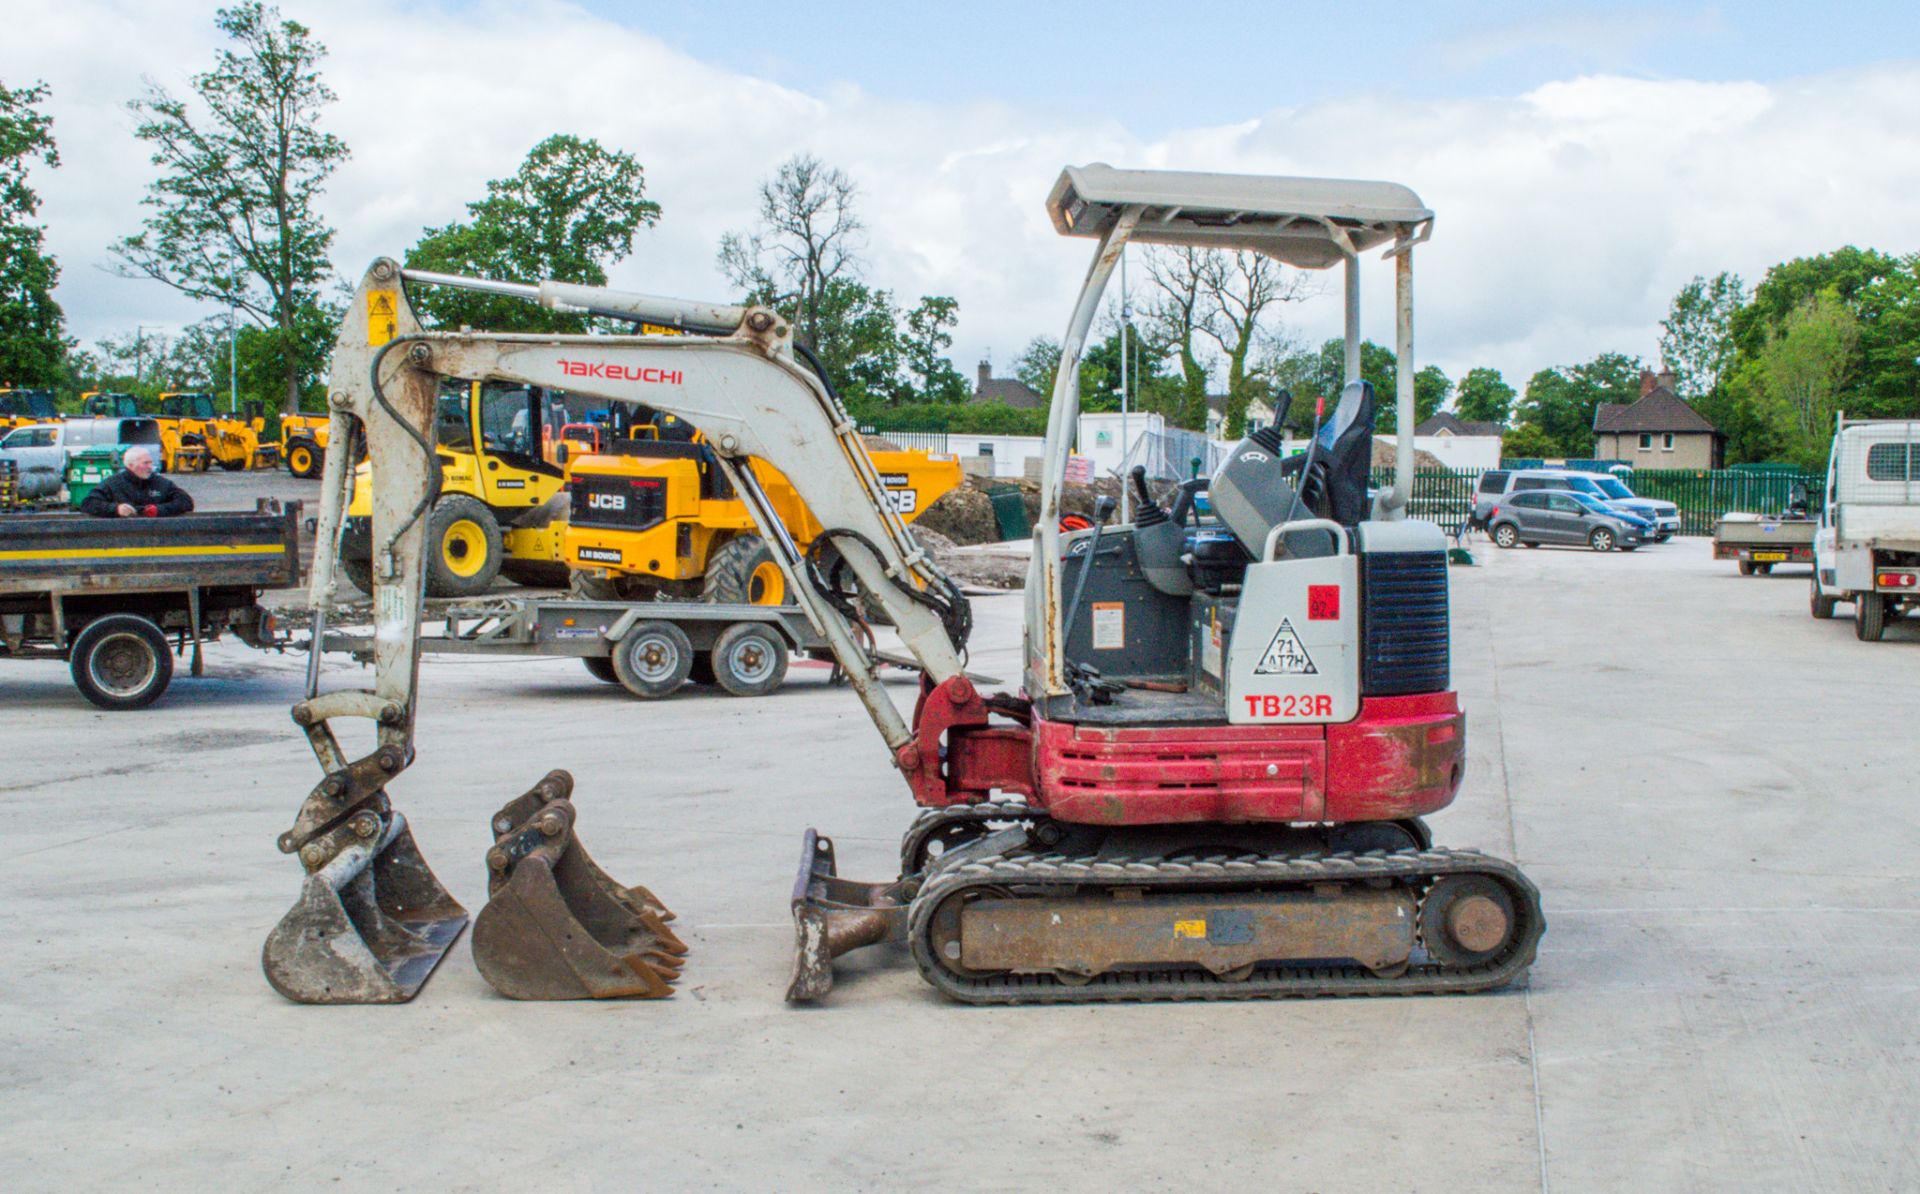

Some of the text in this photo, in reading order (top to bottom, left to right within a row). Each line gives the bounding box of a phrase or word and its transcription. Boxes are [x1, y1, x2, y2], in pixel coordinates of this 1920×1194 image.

[588, 493, 626, 510] JCB
[1277, 639, 1294, 653] 71
[1244, 694, 1332, 717] TB23R
